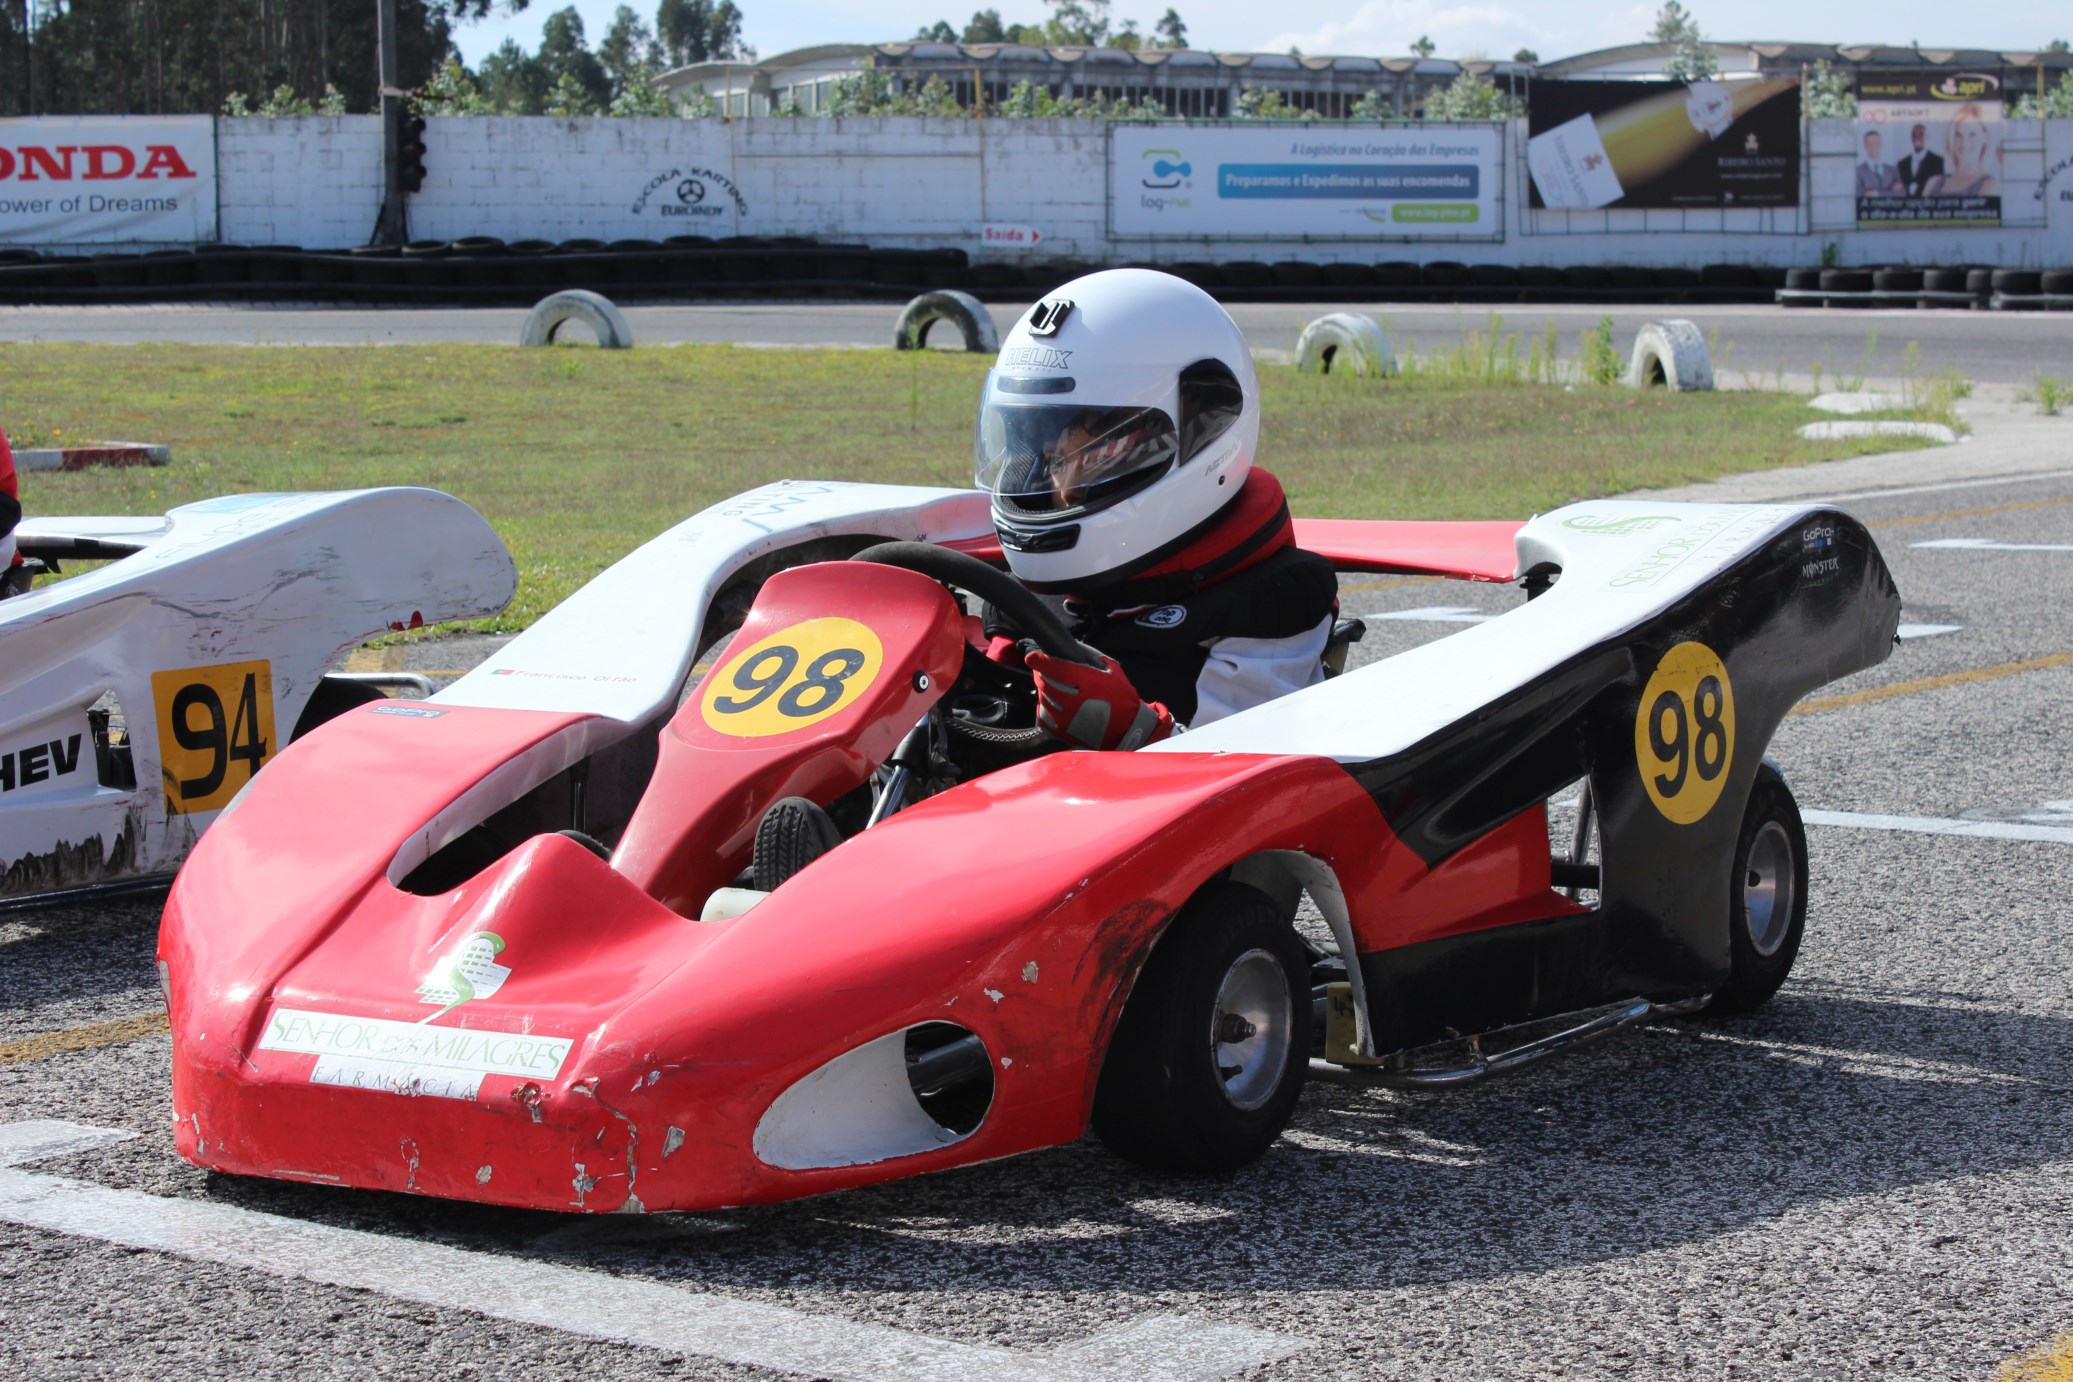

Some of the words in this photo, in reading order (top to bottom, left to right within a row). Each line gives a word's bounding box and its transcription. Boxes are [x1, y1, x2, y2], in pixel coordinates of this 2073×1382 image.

[1407, 143, 1427, 156] das
[1429, 143, 1480, 158] Empresas
[60, 194, 82, 213] of
[90, 194, 178, 213] Dreams
[1005, 347, 1073, 370] HELIX
[1802, 557, 1840, 579] MONSTER
[516, 670, 586, 681] Francisco
[714, 645, 866, 717] 98
[172, 672, 268, 800] 94
[1649, 675, 1727, 798] 98
[270, 1012, 372, 1052] SENHOR
[421, 1036, 567, 1070] MILAGRES
